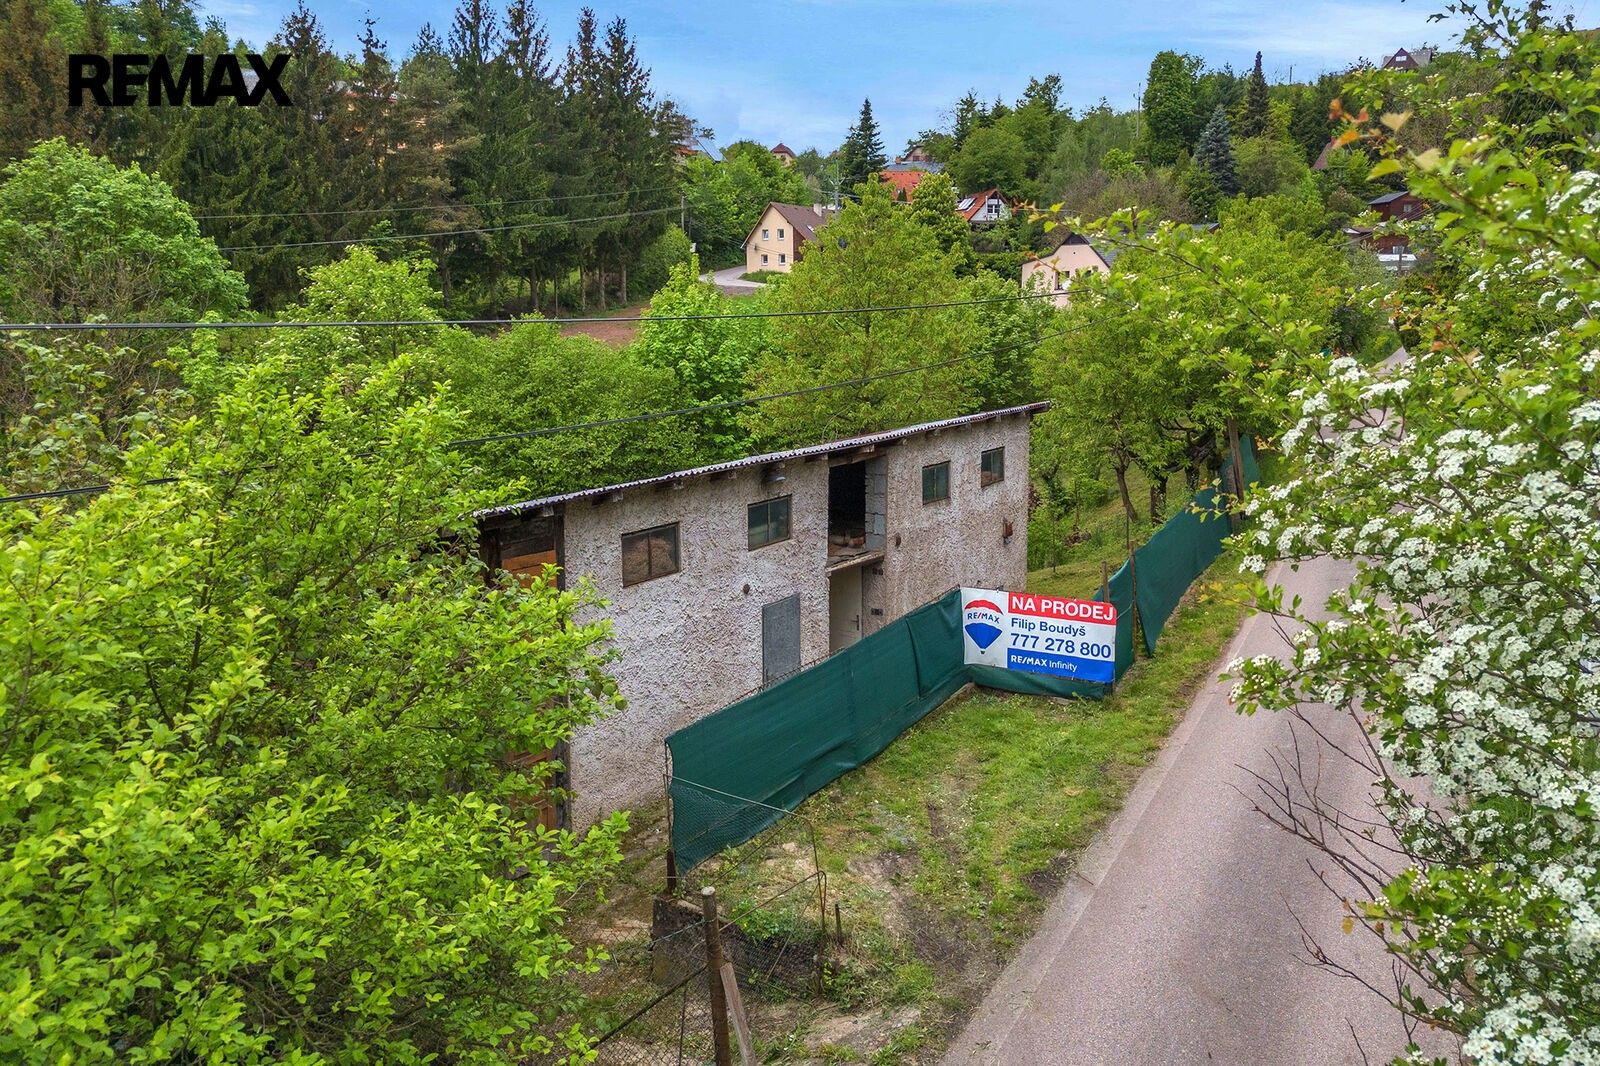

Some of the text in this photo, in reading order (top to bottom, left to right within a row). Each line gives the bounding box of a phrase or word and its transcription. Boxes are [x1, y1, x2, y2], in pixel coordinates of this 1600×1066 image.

[967, 612, 1000, 624] RE/MAX
[1012, 596, 1114, 621] NA PRODEJ
[1011, 618, 1086, 637] Filip Boudyš
[1010, 633, 1111, 658] 777 278 800
[1010, 655, 1077, 672] RE/MAX Infinity
